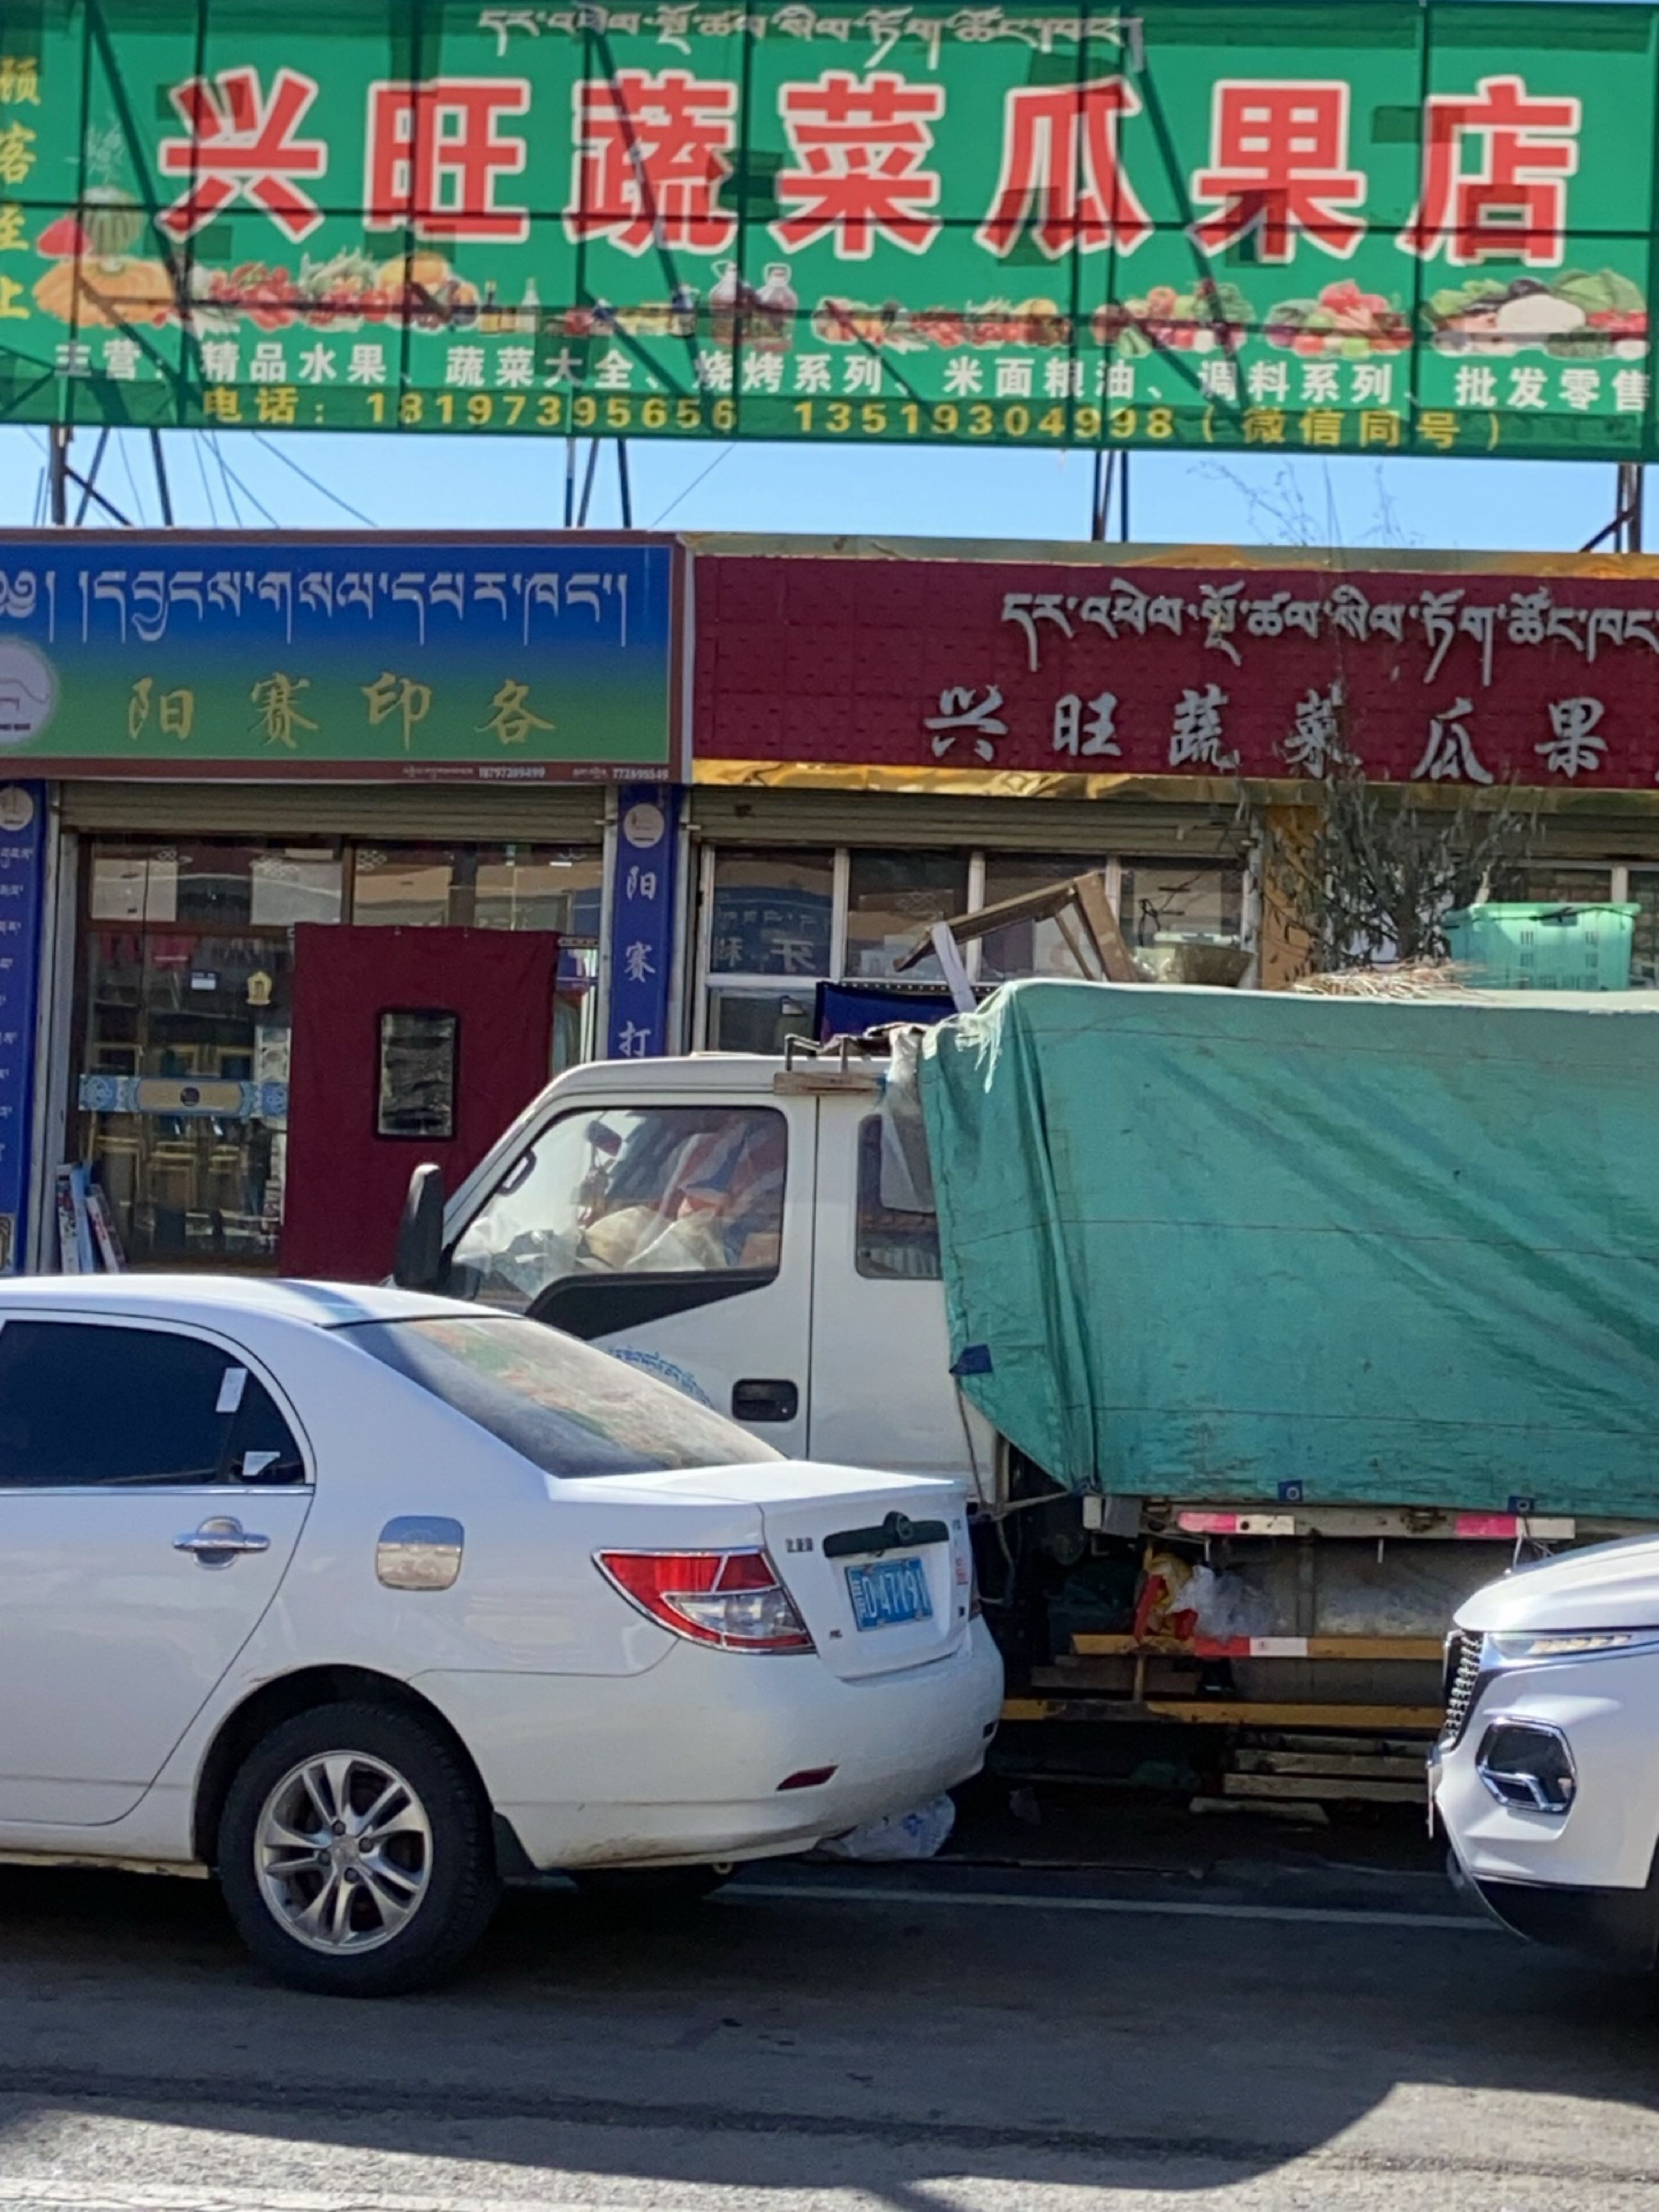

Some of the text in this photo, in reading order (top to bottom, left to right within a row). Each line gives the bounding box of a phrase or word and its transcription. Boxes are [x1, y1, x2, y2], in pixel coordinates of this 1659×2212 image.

[154, 65, 1582, 267] 兴旺蔬菜瓜果店
[129, 672, 556, 751] 阳赛印各
[924, 680, 1659, 785] 兴旺蔬菜瓜果
